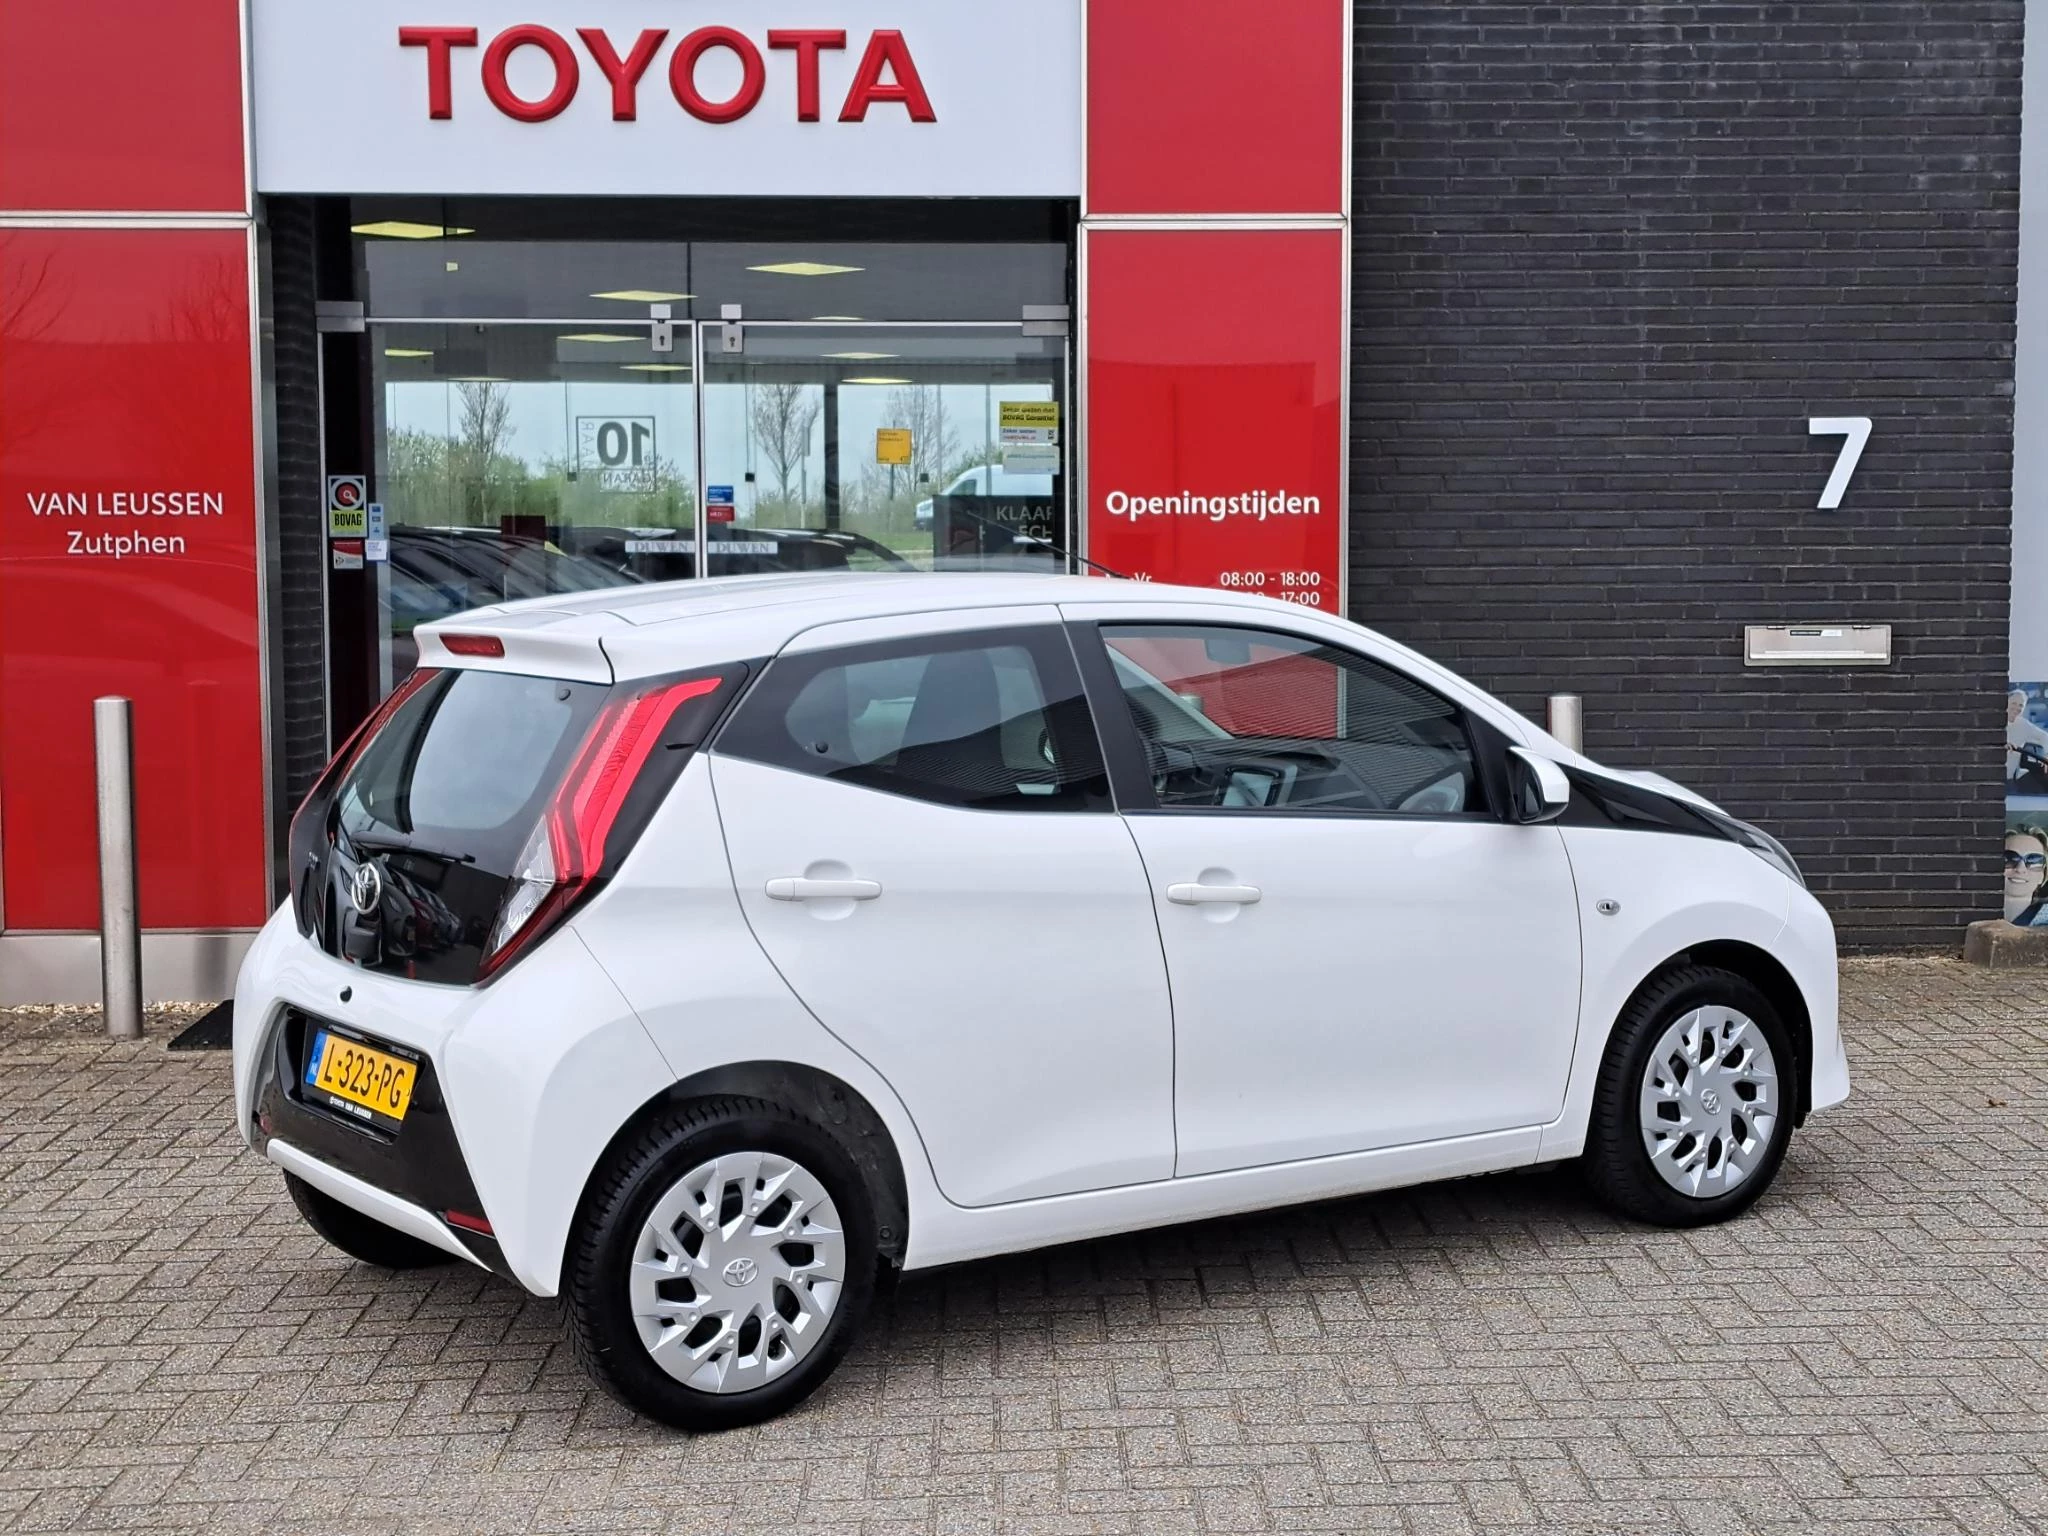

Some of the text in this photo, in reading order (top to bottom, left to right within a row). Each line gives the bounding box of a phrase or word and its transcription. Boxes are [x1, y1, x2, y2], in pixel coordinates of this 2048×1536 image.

[399, 24, 933, 122] TOYOTA
[1808, 417, 1873, 509] 7
[26, 492, 223, 516] VAN LEUSSEN
[1106, 490, 1320, 521] Openingstijden
[334, 513, 362, 526] BOVAG
[66, 529, 185, 559] Zutphen
[1220, 572, 1266, 586] 08:00
[1280, 572, 1321, 586] 18:00
[323, 1042, 406, 1109] L-323-PG
